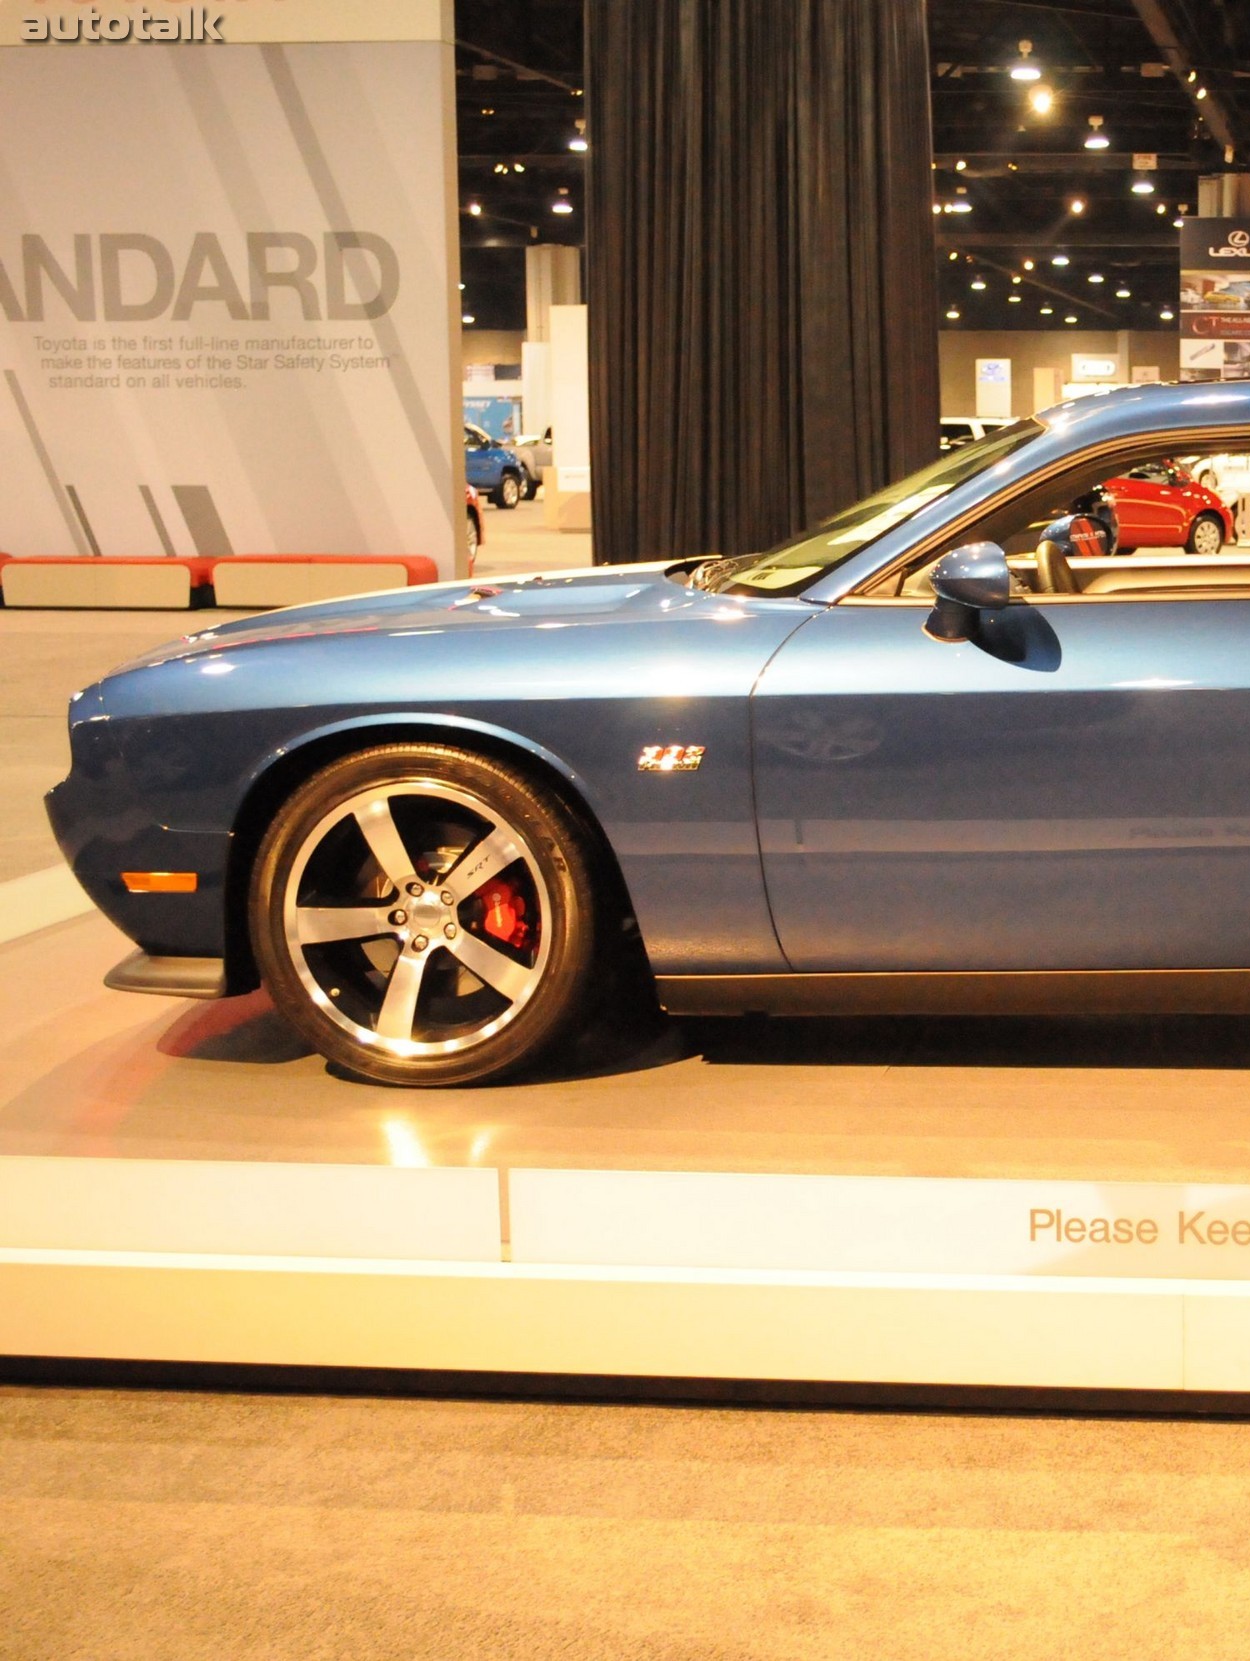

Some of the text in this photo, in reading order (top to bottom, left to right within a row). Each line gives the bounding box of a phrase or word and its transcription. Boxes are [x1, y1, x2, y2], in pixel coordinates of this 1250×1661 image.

[33, 335, 374, 354] Toyota is the first full-line manufacturer to
[41, 354, 391, 372] make the features of the Star Safety System
[49, 374, 247, 389] standard on all vehicles.
[466, 854, 491, 879] SRT
[1029, 1208, 1159, 1244] Please
